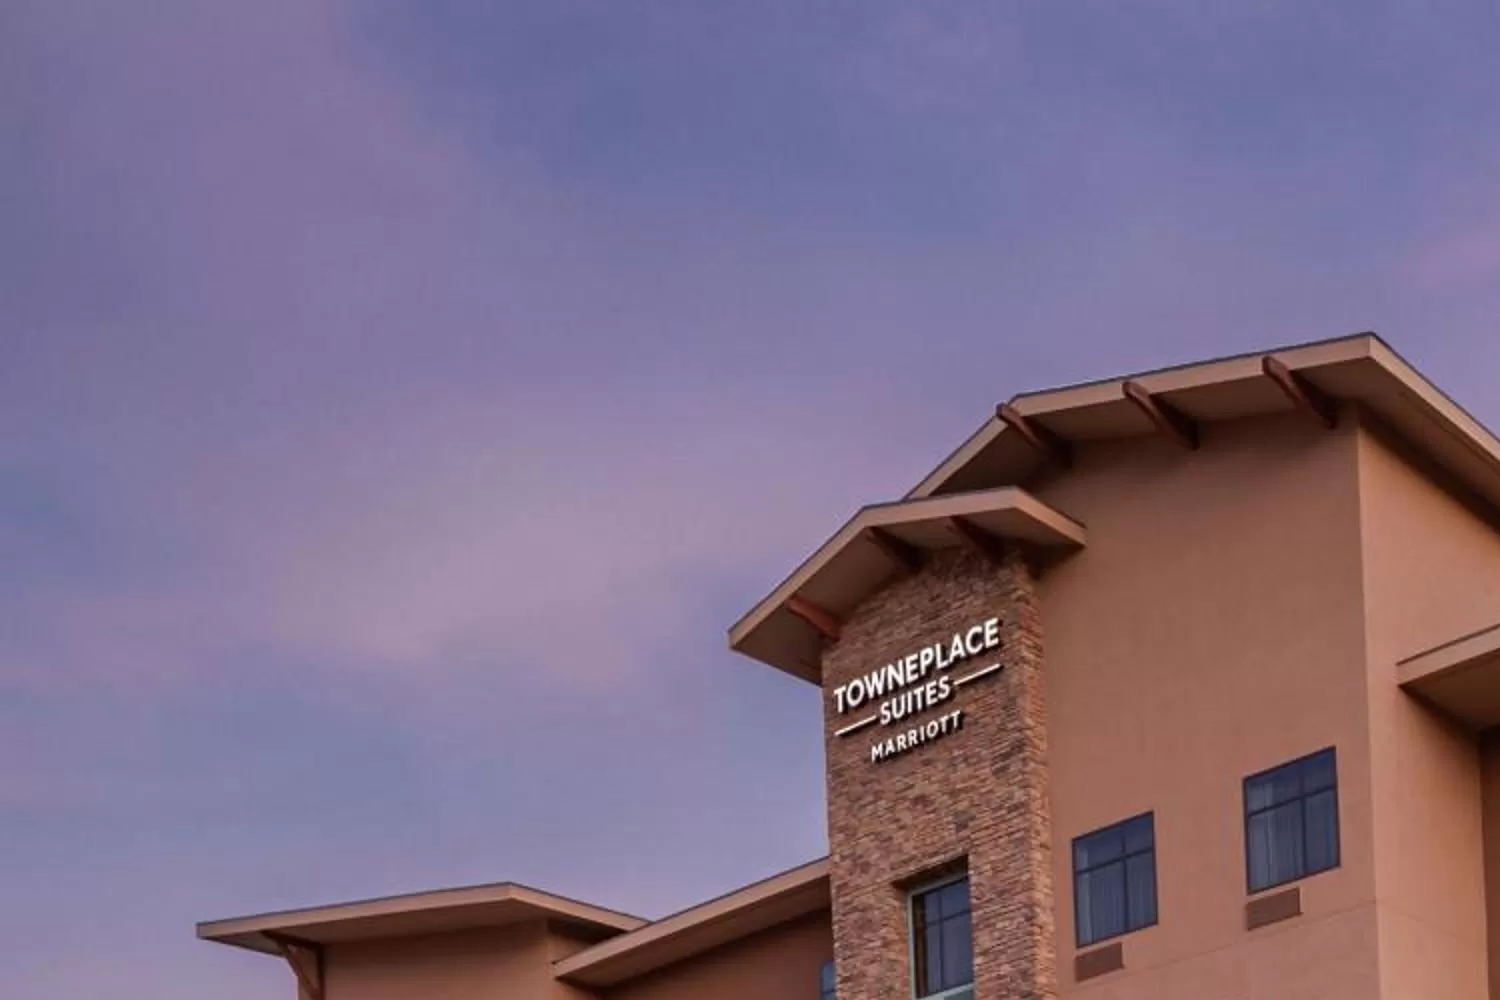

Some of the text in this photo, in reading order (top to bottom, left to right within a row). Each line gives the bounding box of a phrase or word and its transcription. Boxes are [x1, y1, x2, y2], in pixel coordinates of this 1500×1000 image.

[833, 617, 999, 714] TOWNEPLACE
[879, 675, 951, 726] SUITES
[870, 709, 962, 762] MARRIOTT
